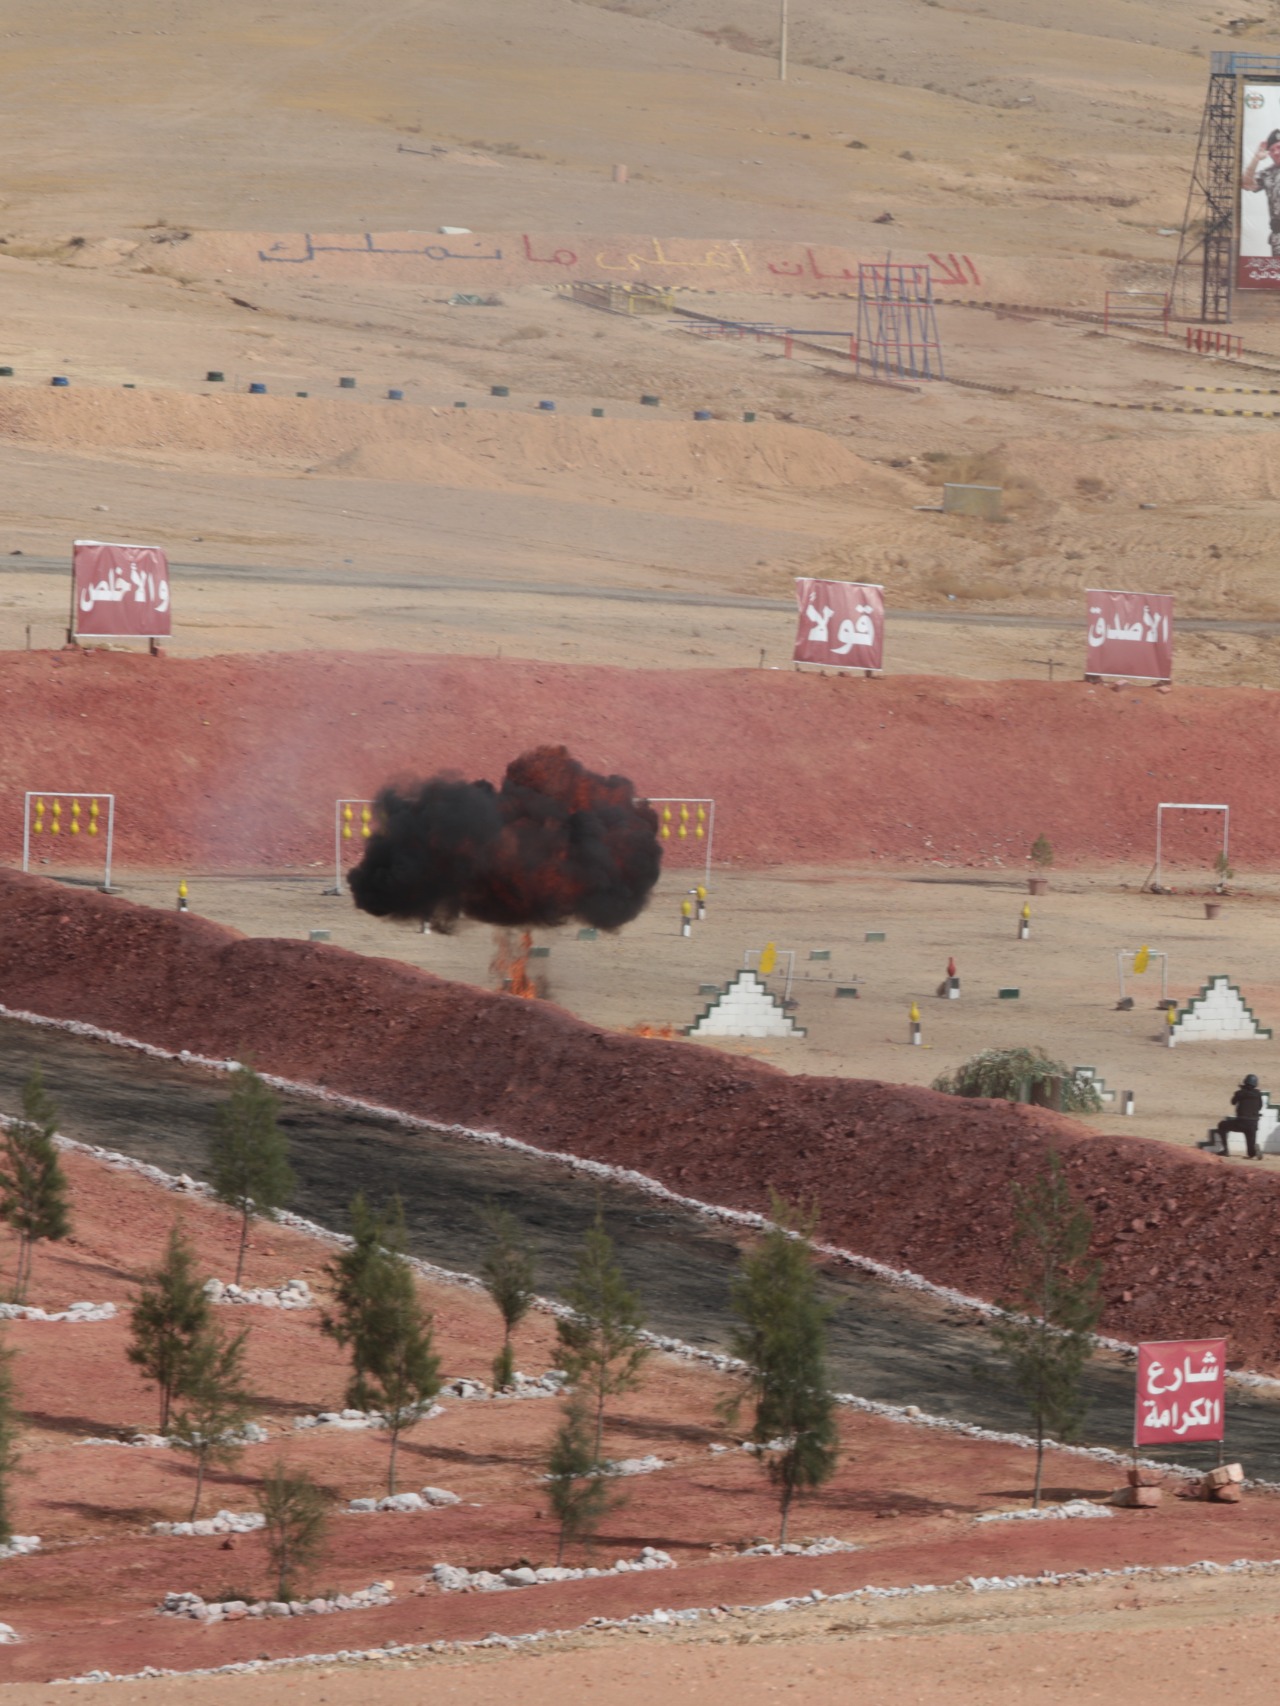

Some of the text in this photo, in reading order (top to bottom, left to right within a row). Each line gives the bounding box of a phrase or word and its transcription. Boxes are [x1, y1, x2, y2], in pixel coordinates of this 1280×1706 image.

[257, 232, 503, 263] نملك
[522, 234, 578, 266] ما
[80, 562, 170, 613] والأخلص
[1087, 604, 1169, 648] الأصدق
[1146, 1351, 1219, 1395] شارع
[1142, 1397, 1220, 1435] الكرامة
